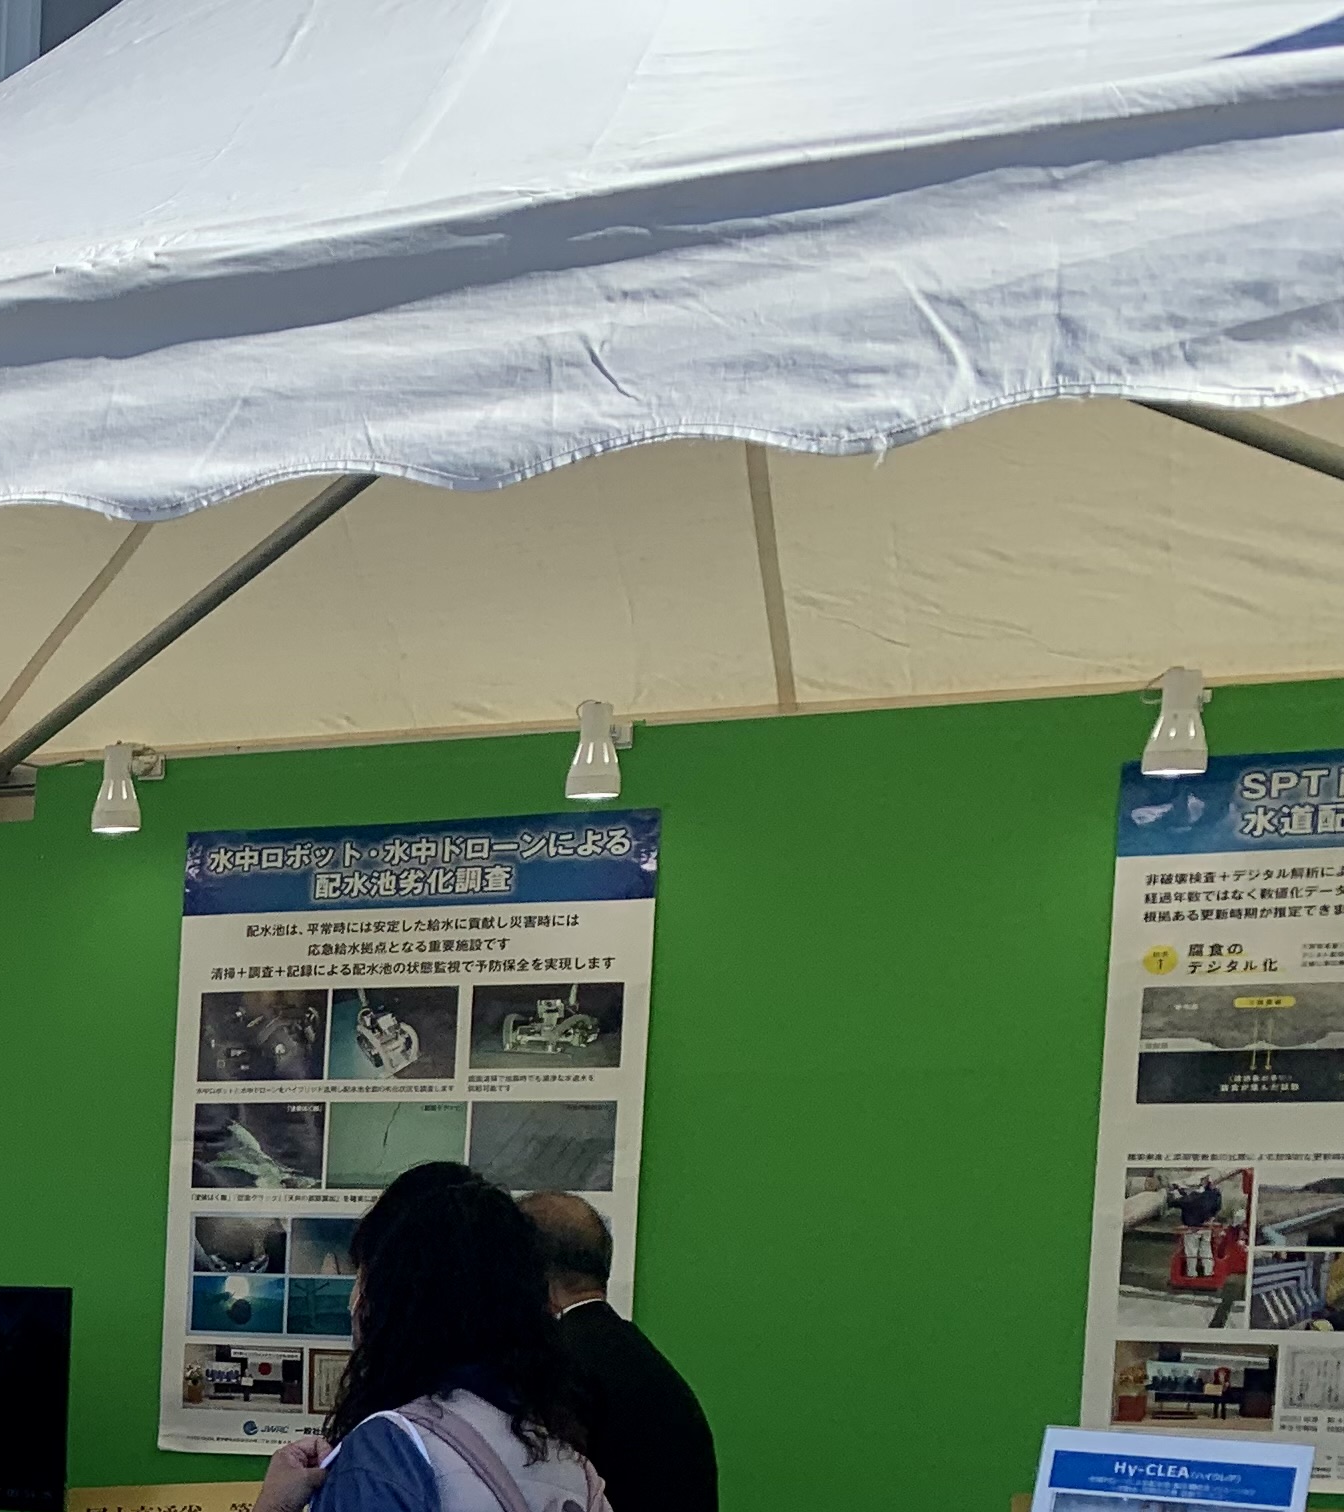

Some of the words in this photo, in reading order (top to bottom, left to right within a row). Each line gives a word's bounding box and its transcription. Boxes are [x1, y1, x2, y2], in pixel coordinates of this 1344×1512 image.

[1241, 767, 1330, 800] SPT
[209, 828, 632, 873] 水中ロボット・水中ドローンによる
[314, 865, 513, 900] 配水池劣化調査
[307, 938, 511, 957] 応急給水拠点となる重要施設です
